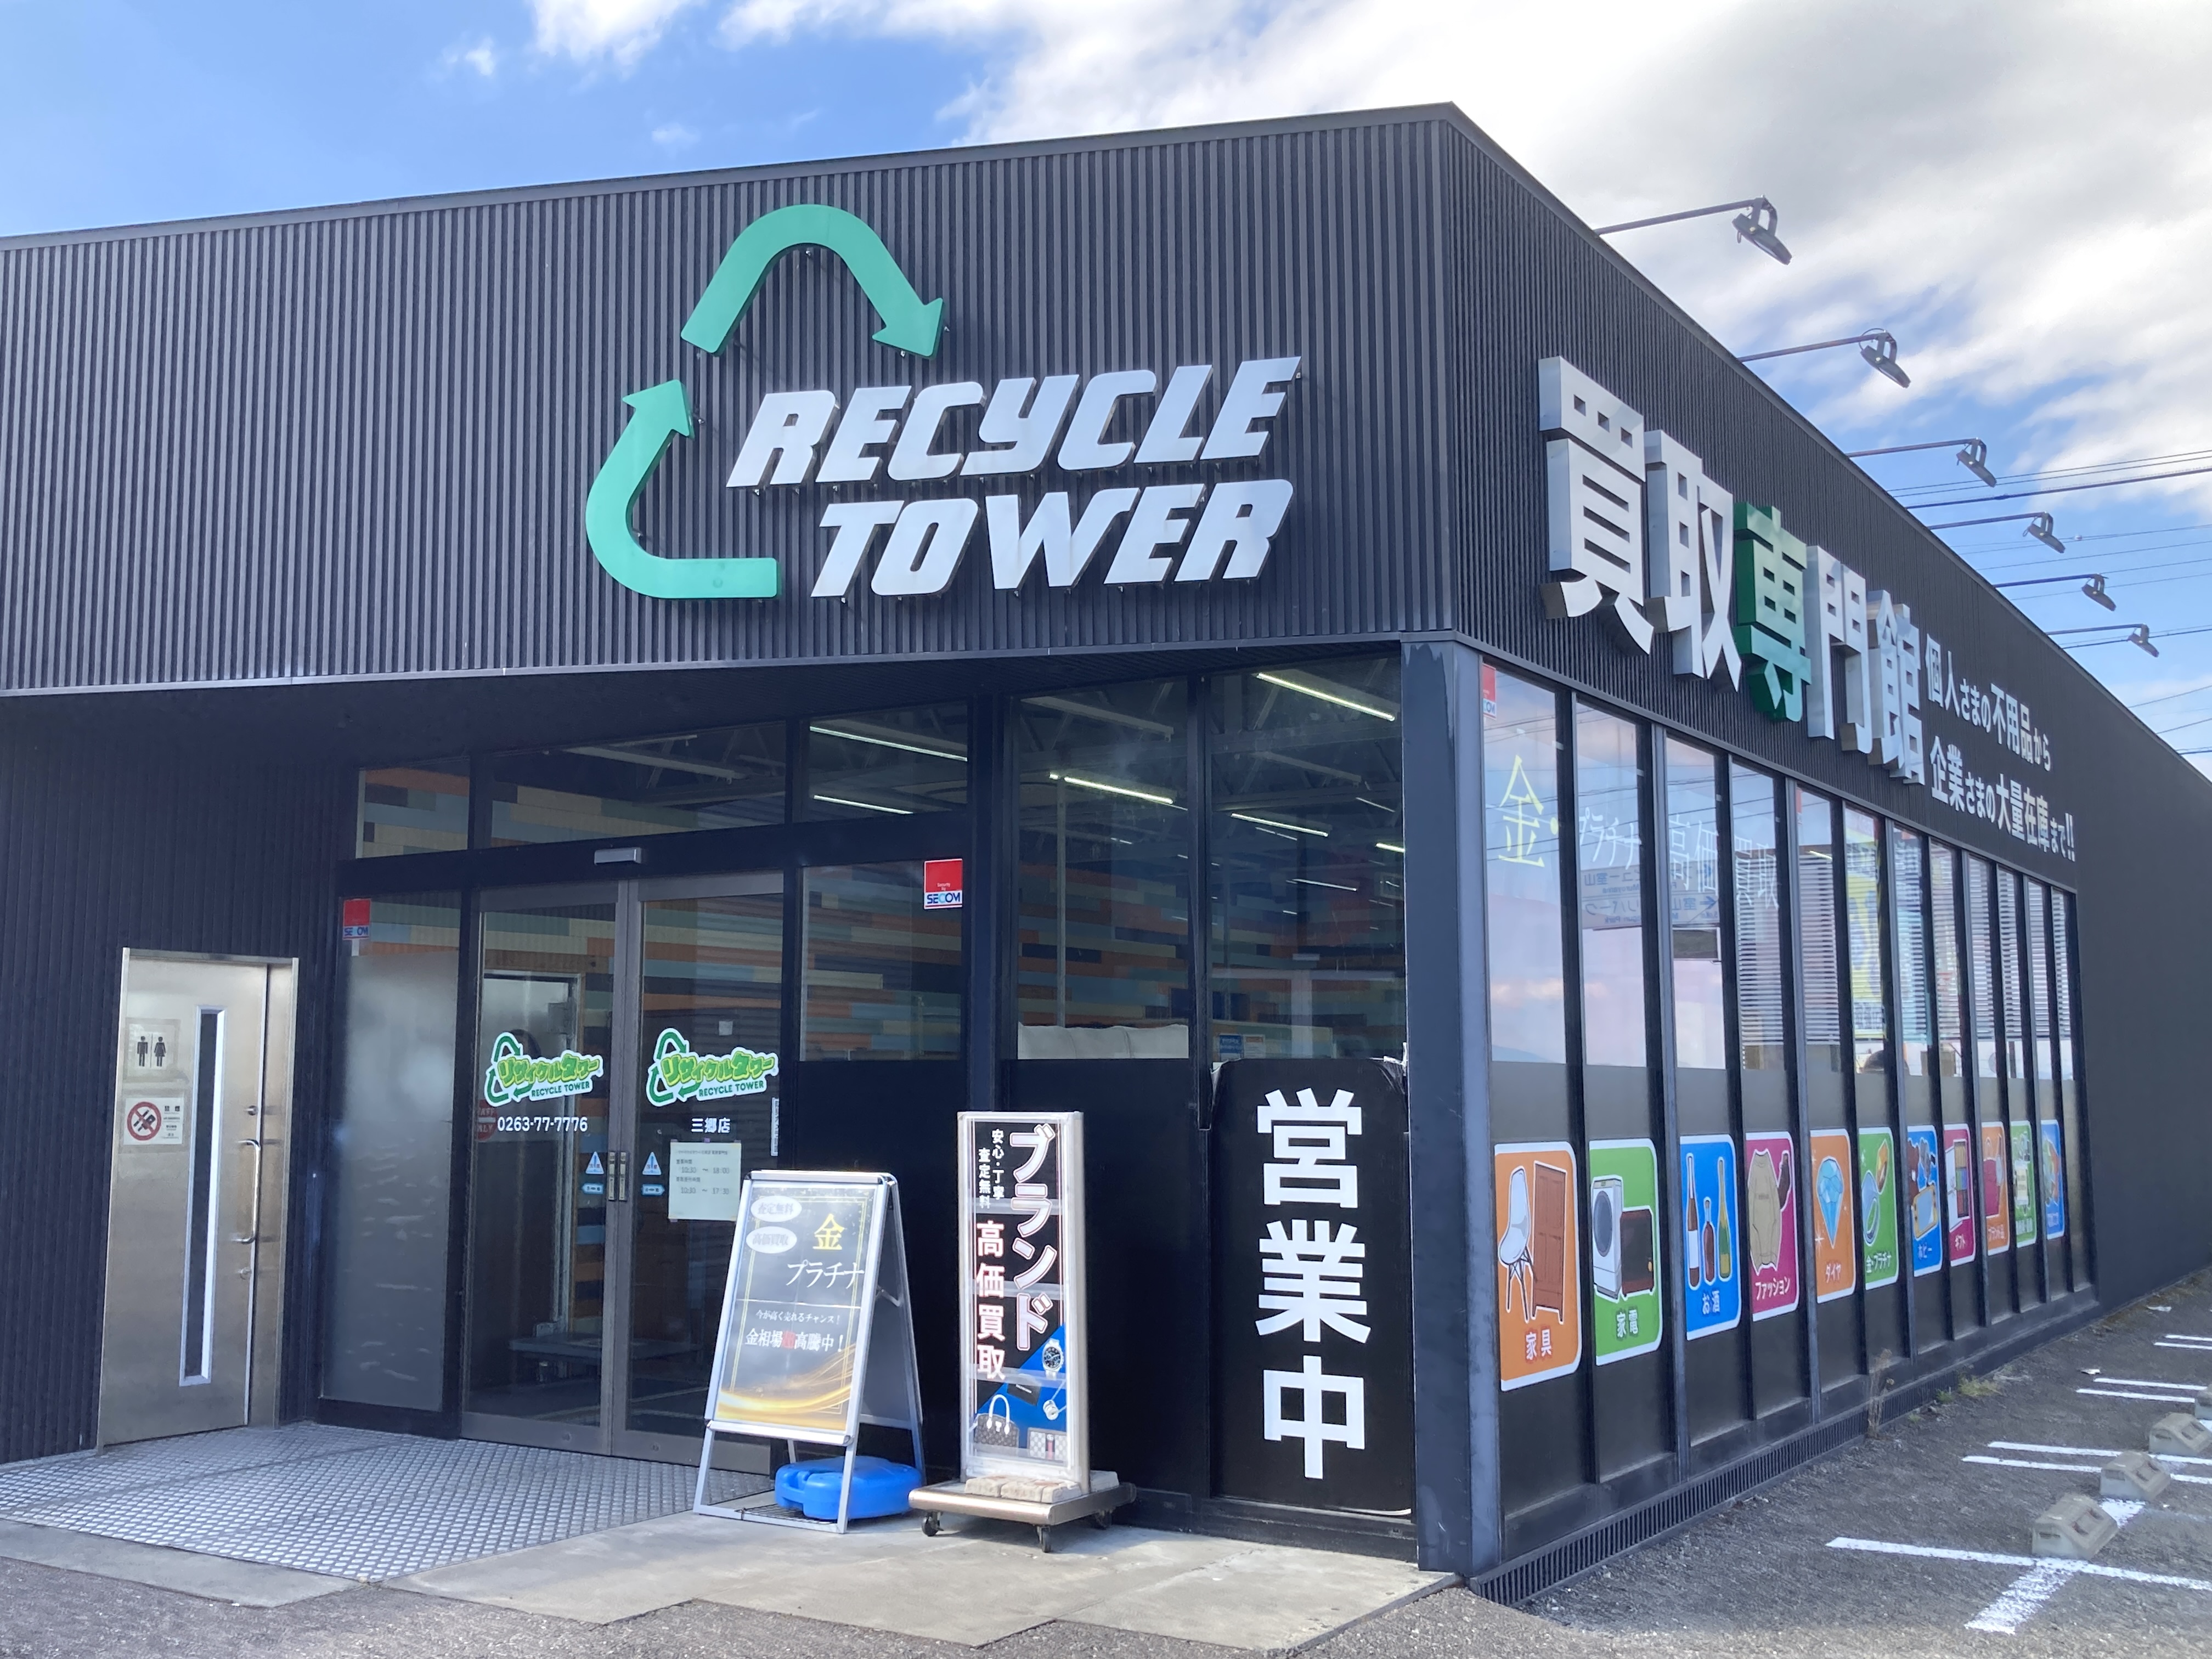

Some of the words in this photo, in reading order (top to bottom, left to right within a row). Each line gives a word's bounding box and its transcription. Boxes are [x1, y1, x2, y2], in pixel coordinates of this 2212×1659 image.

[726, 356, 1301, 488] RECYCLE
[811, 479, 1293, 598] TOWER
[1539, 356, 1926, 786] 買取専門館
[1483, 699, 1496, 714] COM
[1925, 633, 2051, 772] 個人さまの不用品から
[927, 893, 961, 904] SECOM
[498, 1053, 600, 1088] リサイクルタワー
[661, 1051, 775, 1087] リサイクルタワー
[531, 1085, 562, 1097] RECYCLE
[565, 1081, 590, 1092] TOWER
[698, 1085, 733, 1097] RECYCLE
[735, 1080, 764, 1092] TOWER
[497, 1116, 588, 1132] 0263-77-7776
[691, 1118, 730, 1133] 三郷店
[978, 1148, 991, 1209] 査定無料
[758, 1203, 794, 1215] 査定無料
[813, 1214, 845, 1250] 金
[1009, 1123, 1057, 1351] ブランド
[786, 1259, 865, 1289] プラチナ
[1255, 1087, 1372, 1480] 営業中
[1754, 1277, 1791, 1300] ファッション
[1825, 1262, 1842, 1284] ダイヤ
[976, 1220, 1006, 1380] 高価買取
[1702, 1290, 1720, 1315] お酒
[1616, 1308, 1639, 1339] 家電
[1525, 1328, 1553, 1361] 家具
